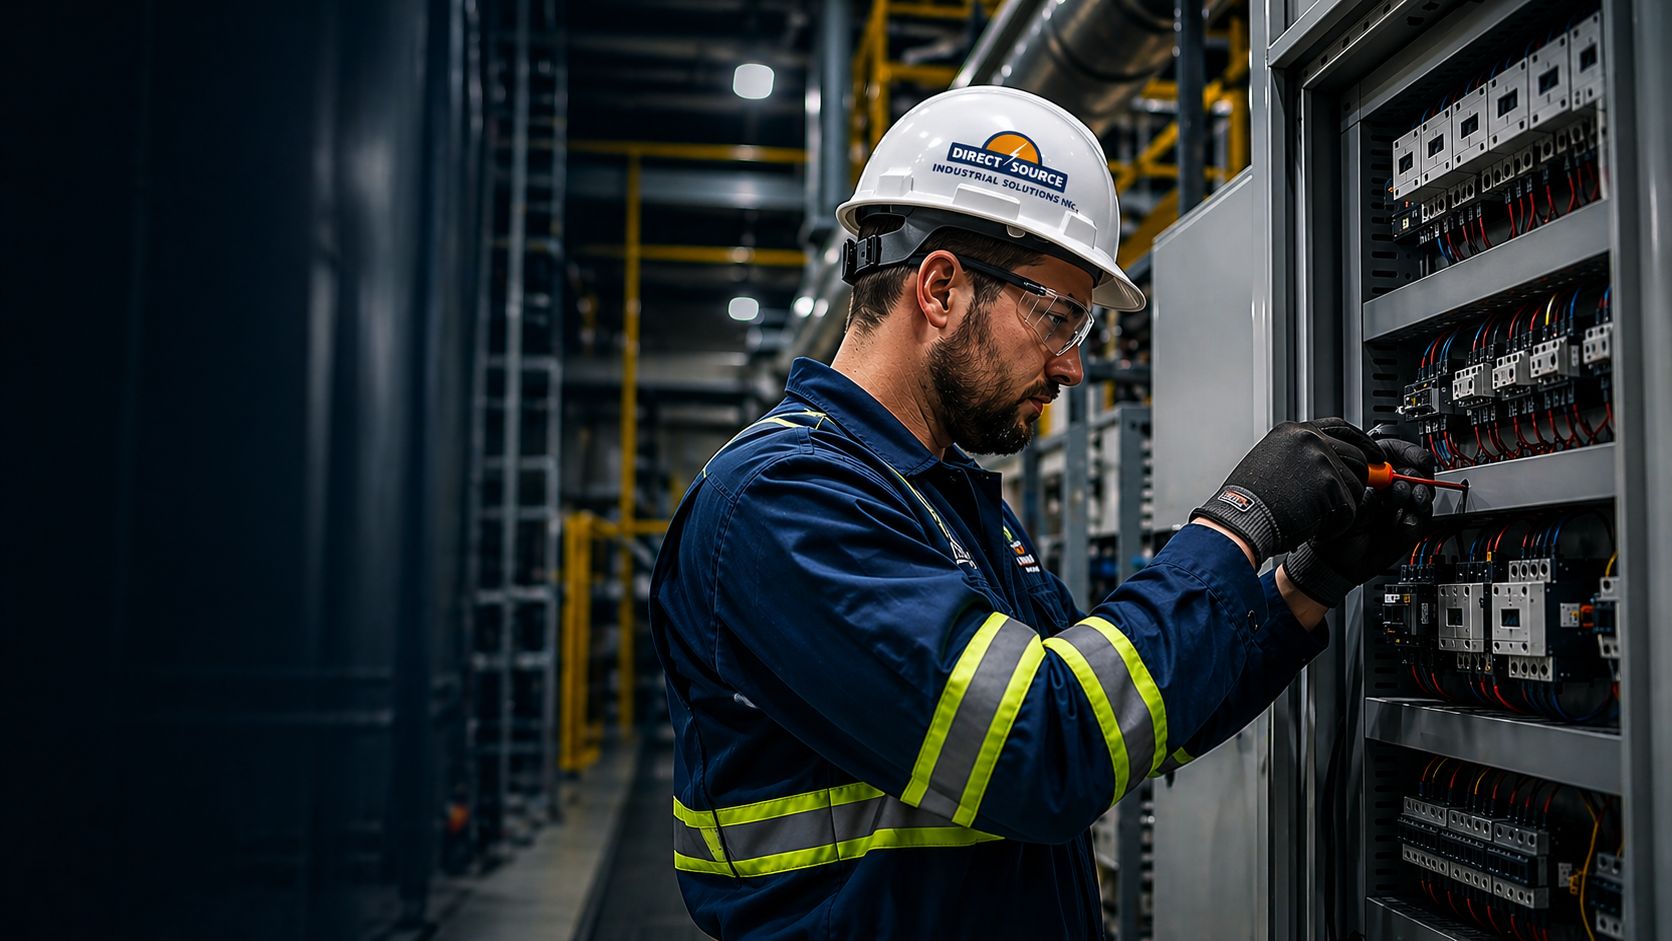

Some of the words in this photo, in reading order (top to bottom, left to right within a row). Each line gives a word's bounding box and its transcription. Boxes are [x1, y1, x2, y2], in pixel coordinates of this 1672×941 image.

[932, 163, 999, 185] INDUSTRIAL
[1001, 178, 1060, 204] SOLUTIONS
[952, 147, 1003, 168] DIRECT
[1010, 161, 1063, 188] SOURCE
